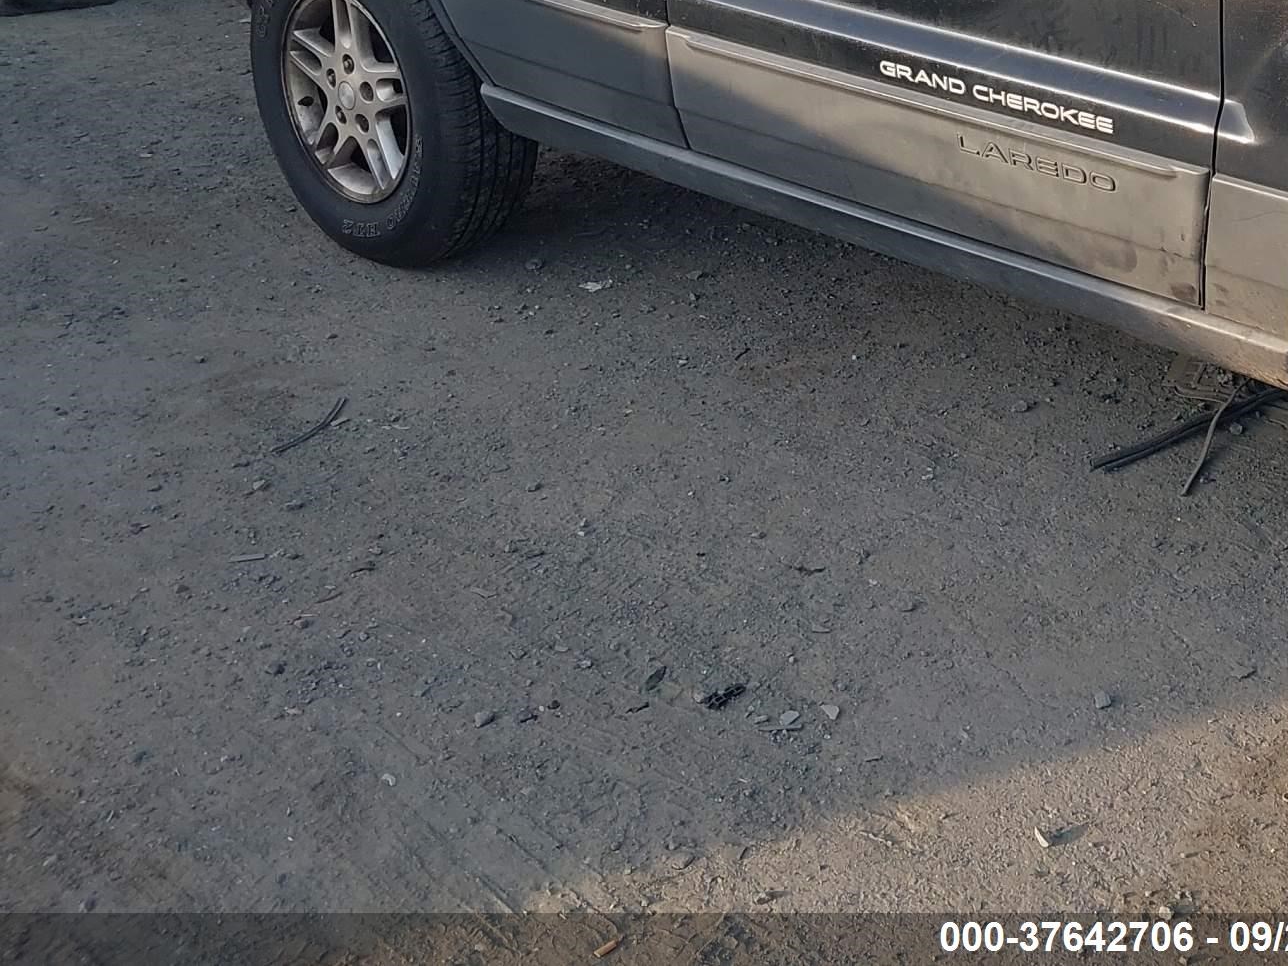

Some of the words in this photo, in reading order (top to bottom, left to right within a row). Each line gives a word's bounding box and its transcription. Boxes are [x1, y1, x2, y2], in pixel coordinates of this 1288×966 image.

[879, 60, 966, 95] GRAND
[972, 84, 1114, 135] CHEROKEE
[956, 133, 1117, 193] LAREDO
